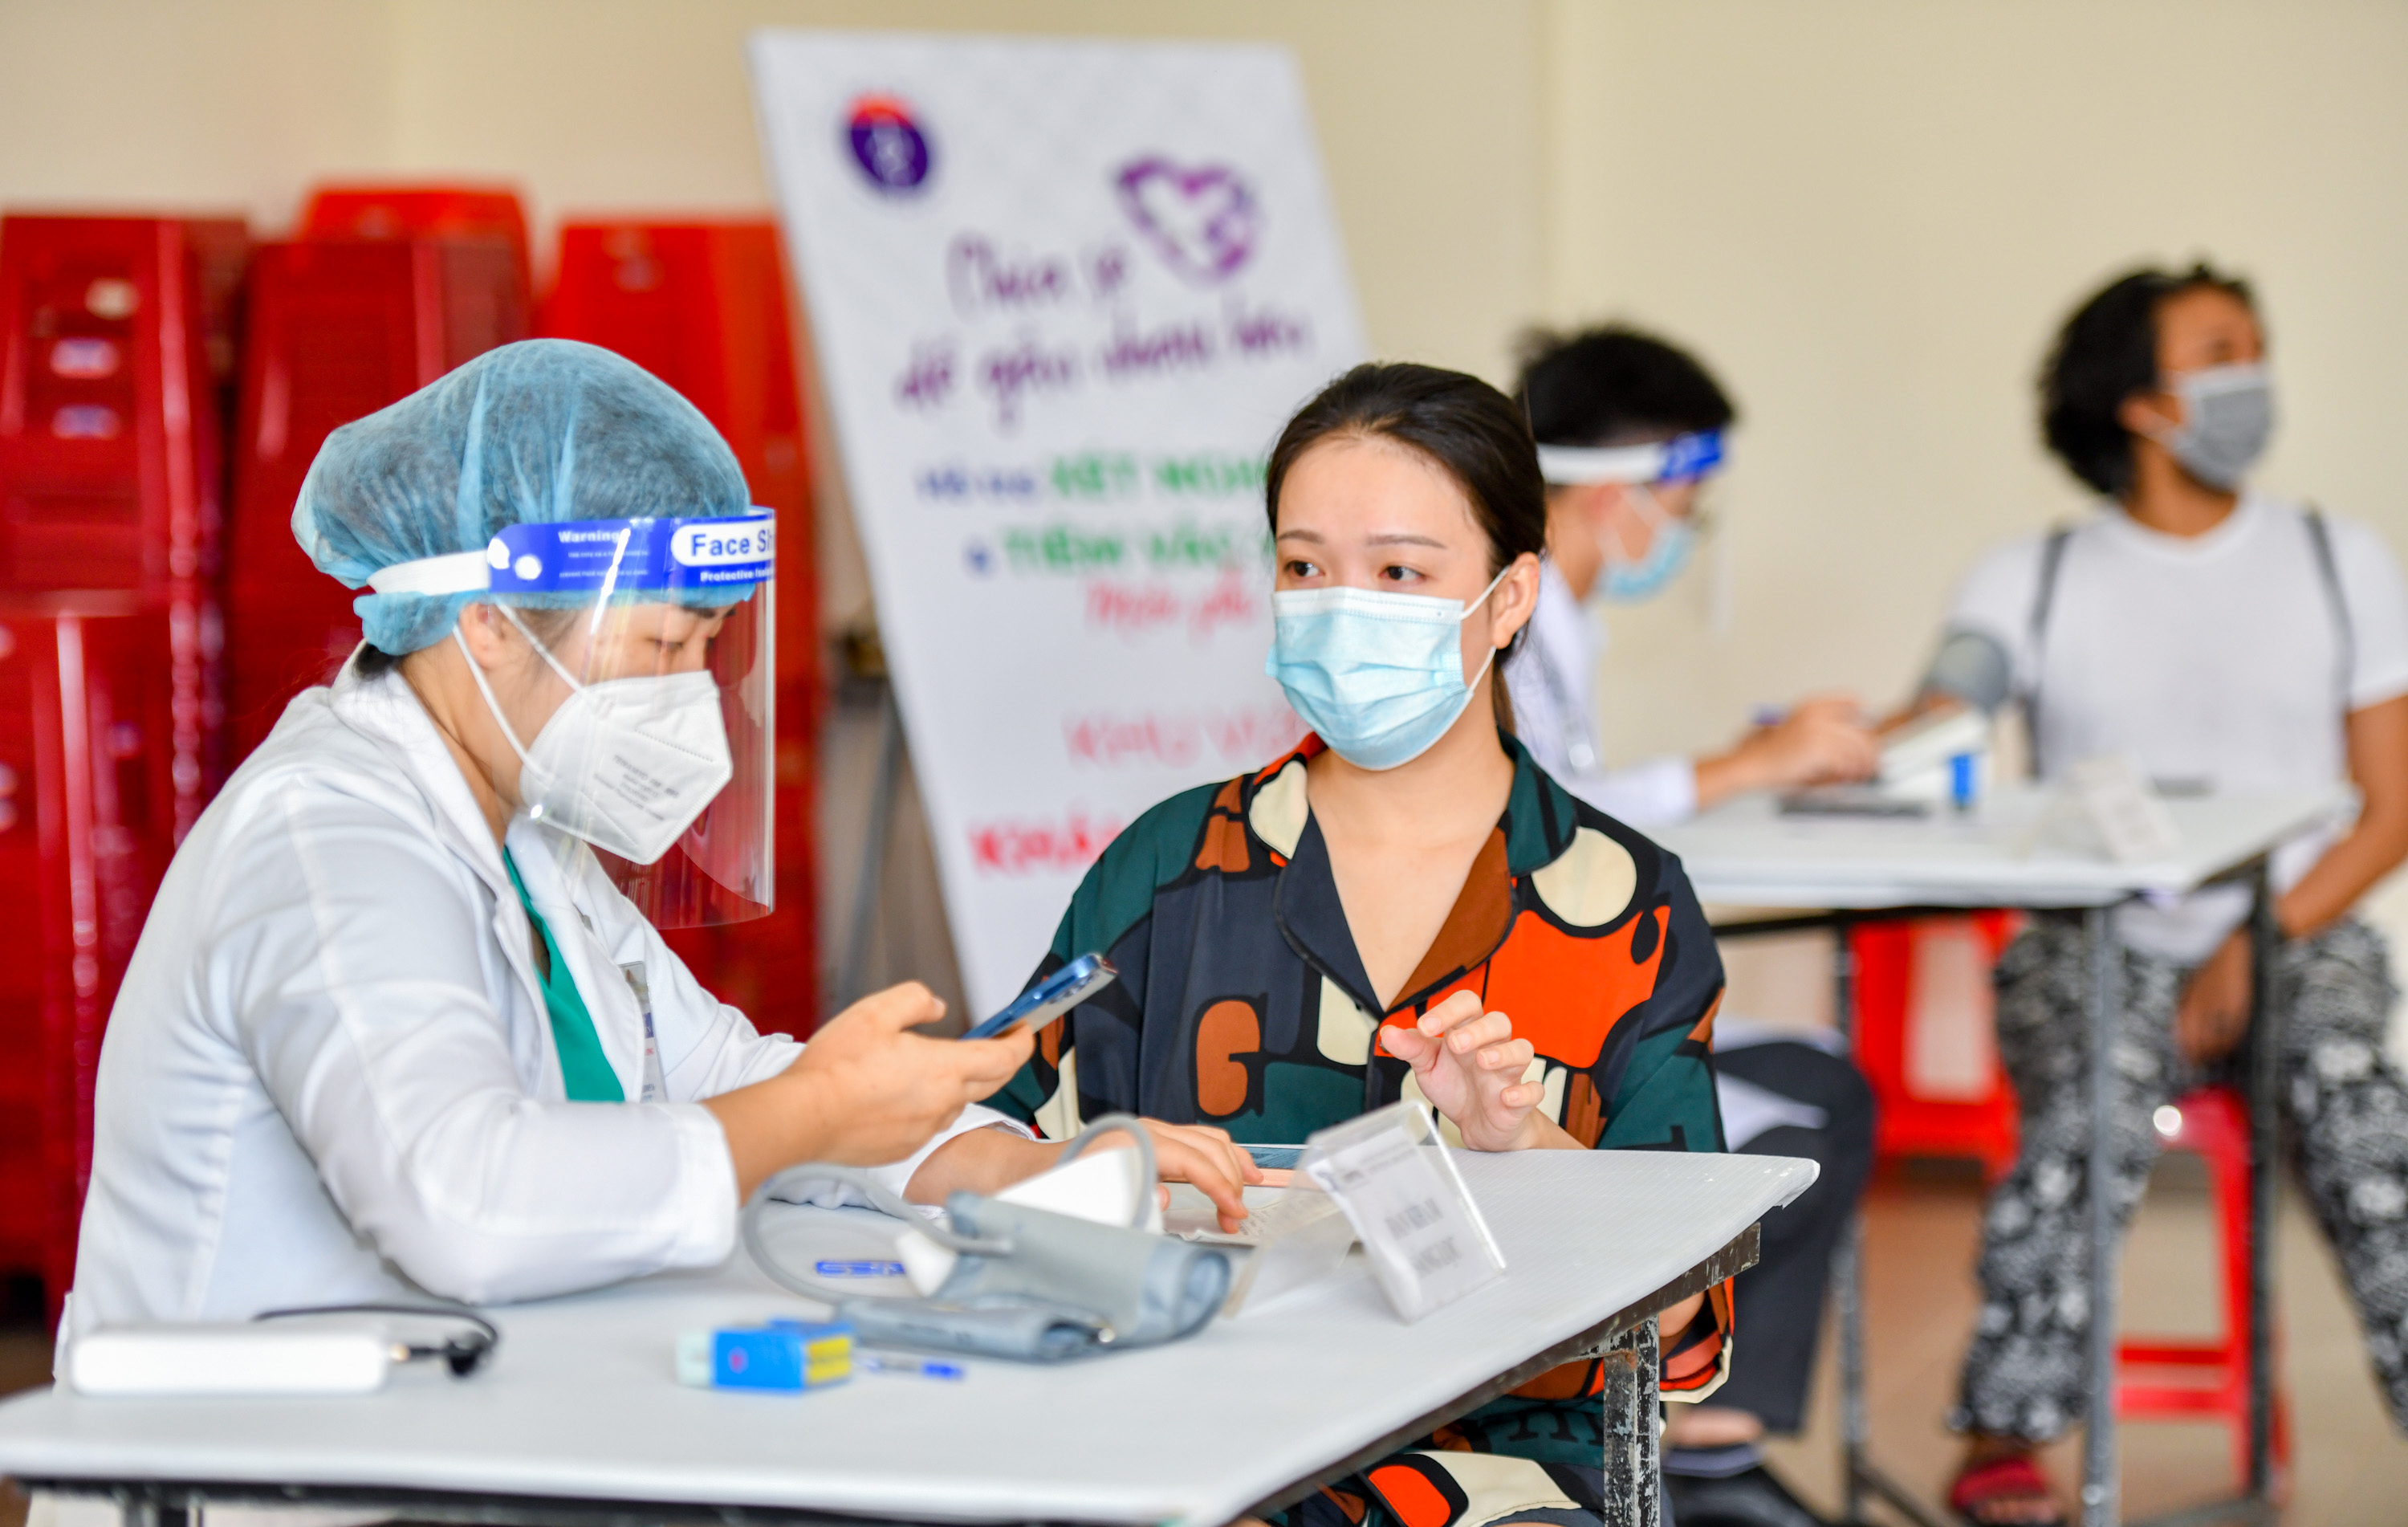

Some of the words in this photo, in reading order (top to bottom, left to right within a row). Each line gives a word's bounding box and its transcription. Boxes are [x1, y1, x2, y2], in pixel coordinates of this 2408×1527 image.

[558, 530, 621, 544] Warning
[691, 533, 750, 556] Face
[700, 569, 753, 582] Protective
